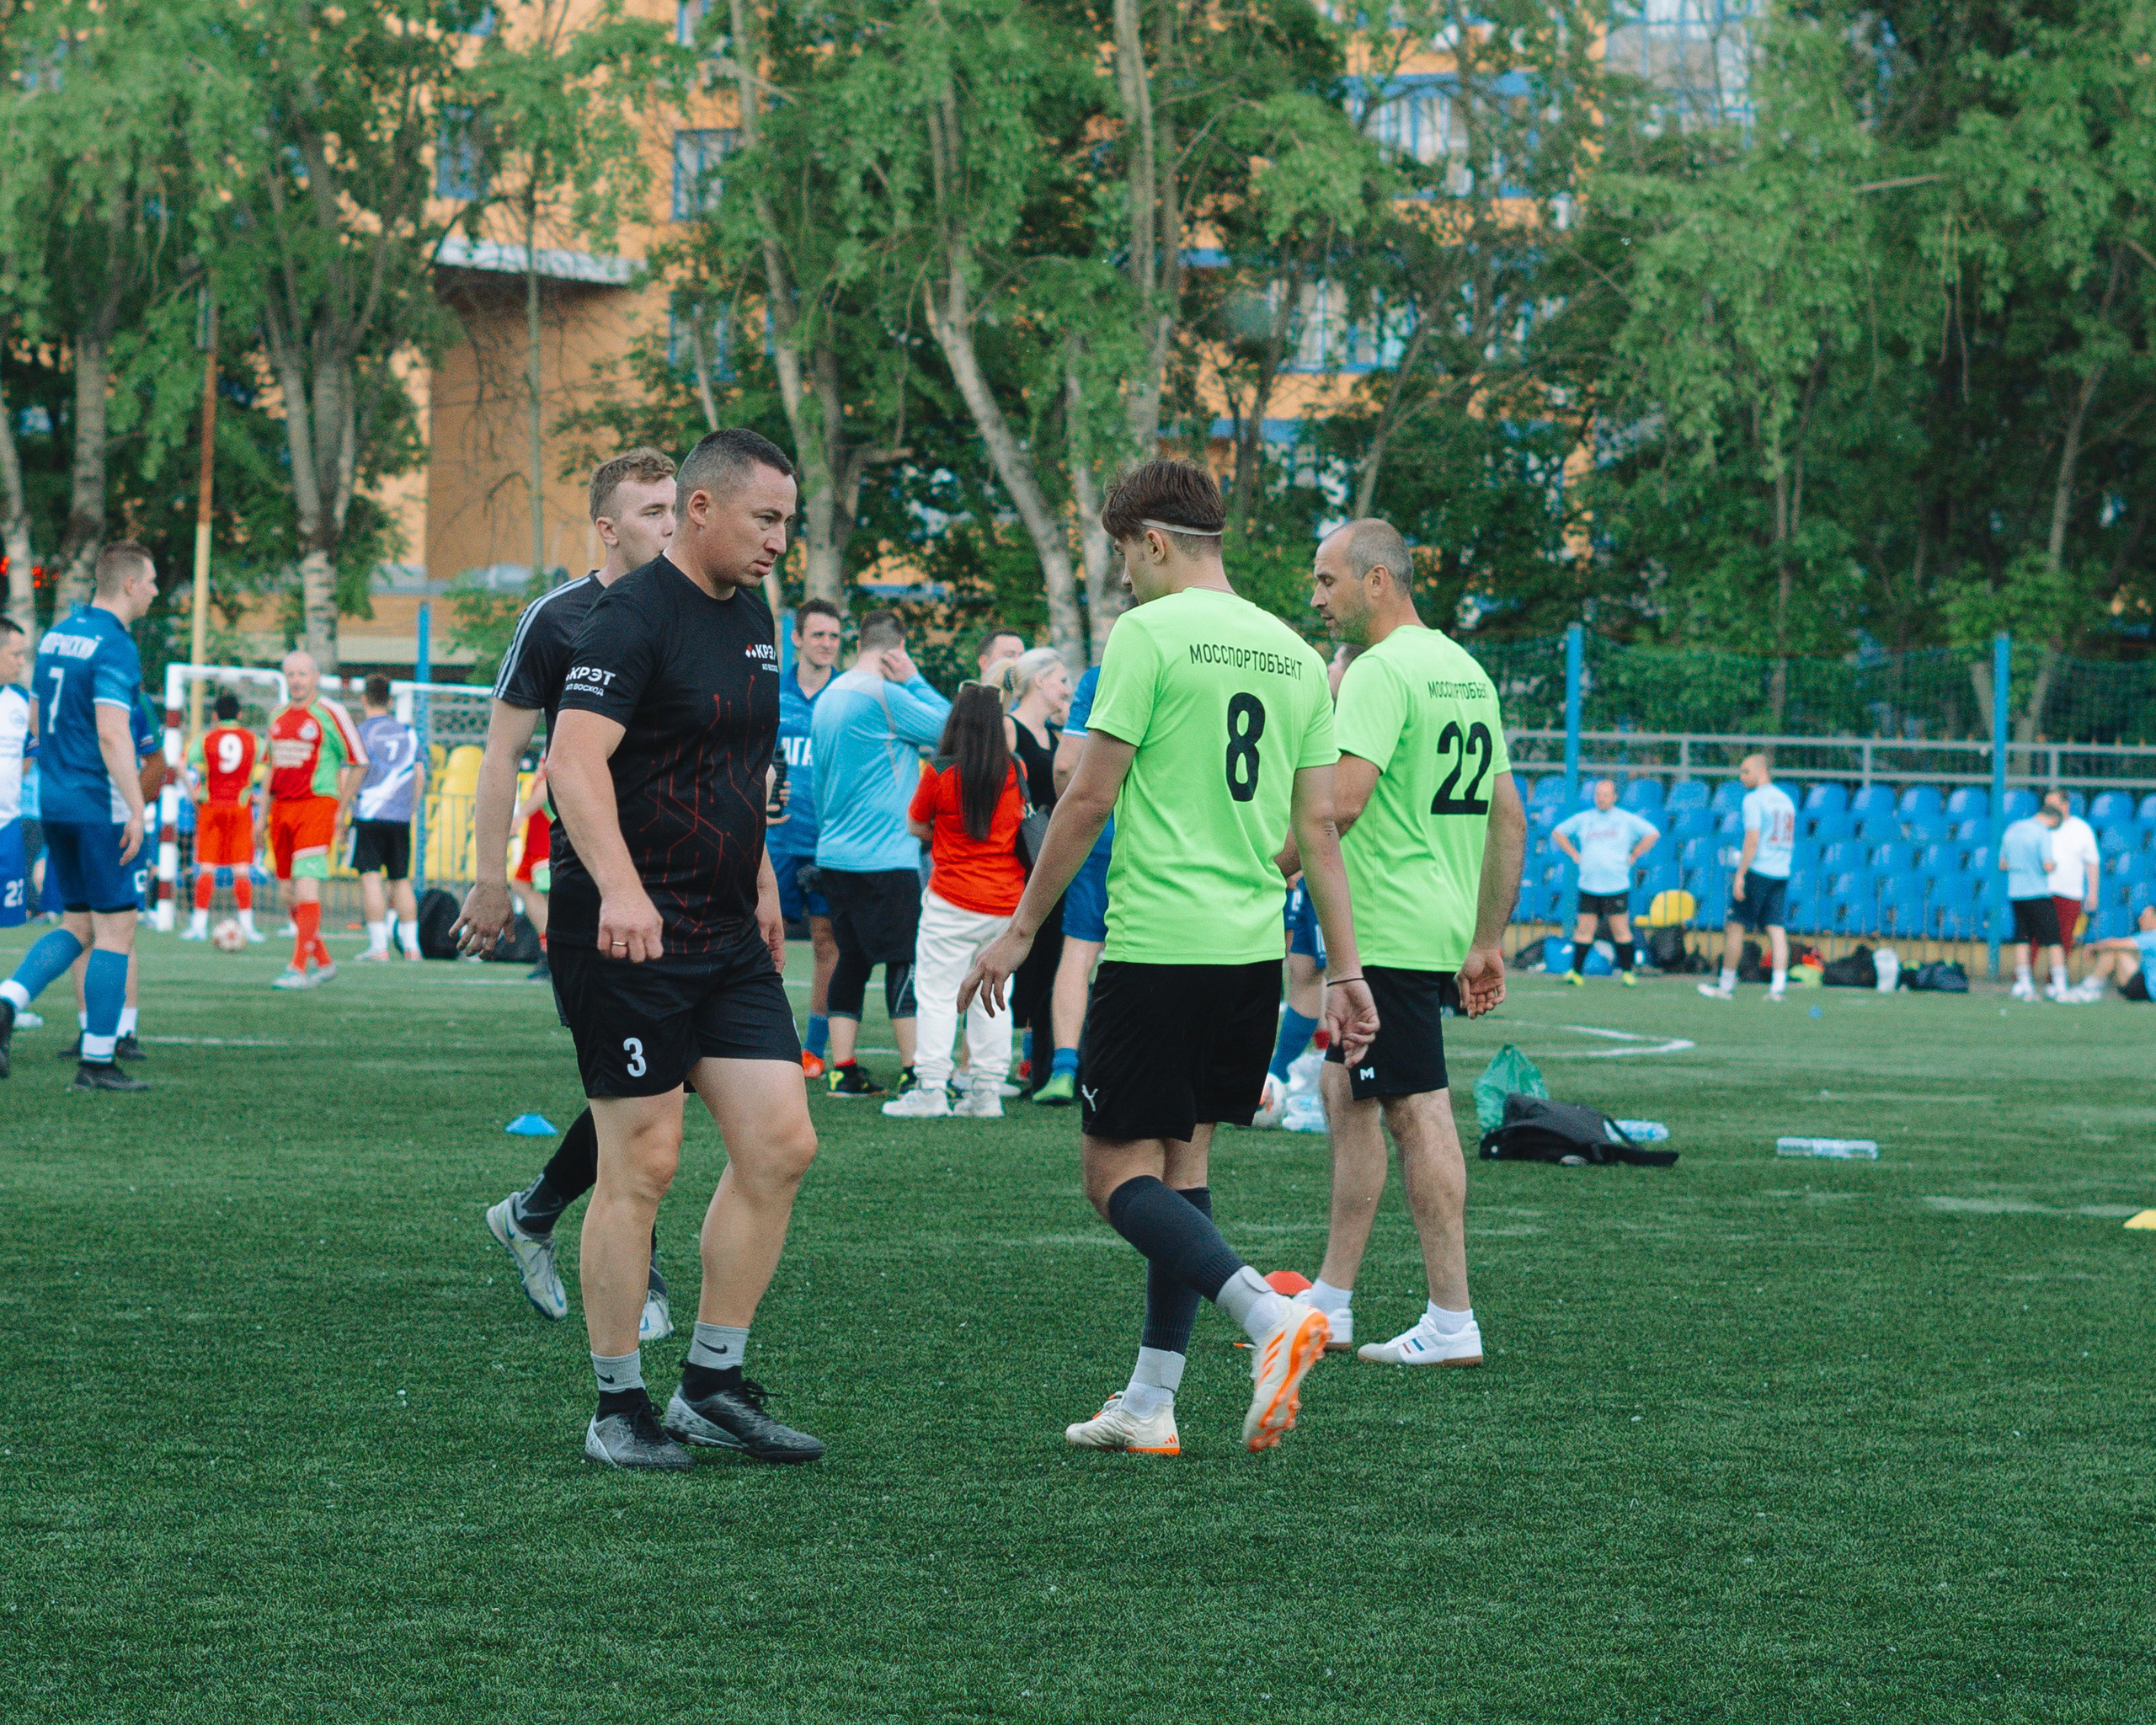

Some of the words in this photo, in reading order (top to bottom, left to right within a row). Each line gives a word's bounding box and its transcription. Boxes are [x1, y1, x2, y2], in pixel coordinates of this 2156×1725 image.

[569, 666, 616, 686] КРЭТ
[1189, 644, 1302, 681] МОССПОРТОБЪЕКТ
[48, 666, 64, 734] 7
[574, 683, 605, 697] ВОСХОД
[218, 733, 243, 774] 9
[385, 740, 399, 761] 7
[1226, 692, 1265, 802] 8
[1430, 720, 1492, 815] 22
[623, 1037, 647, 1077] 3
